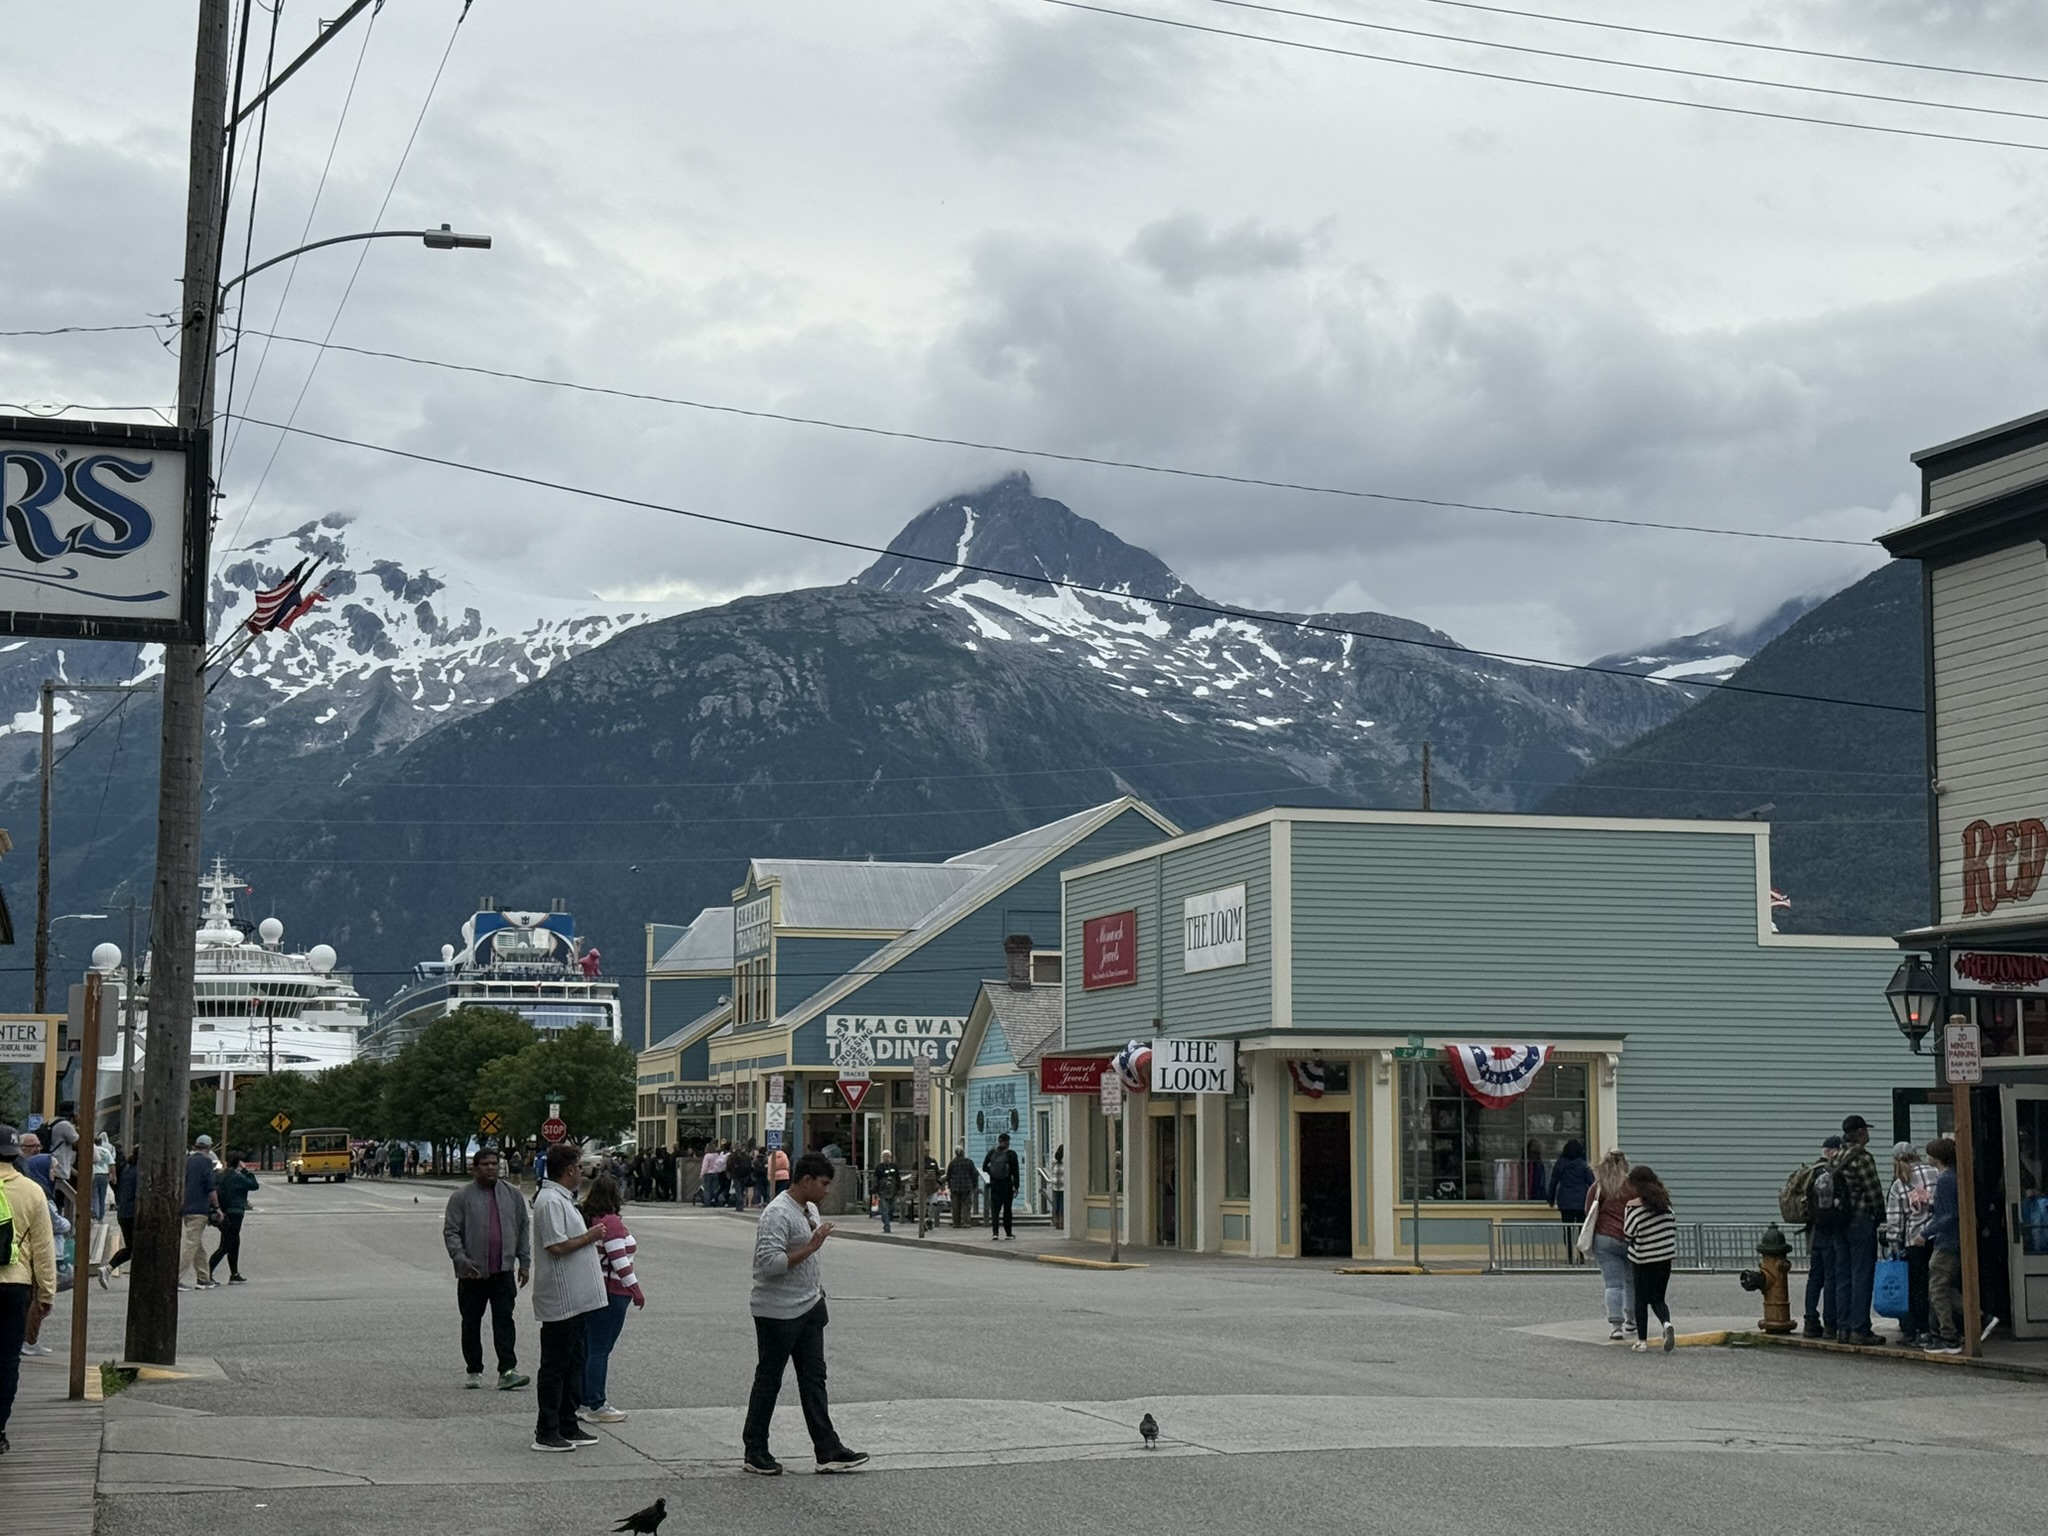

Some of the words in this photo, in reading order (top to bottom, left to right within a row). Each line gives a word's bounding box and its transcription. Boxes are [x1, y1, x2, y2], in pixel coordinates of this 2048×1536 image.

[1961, 818, 2048, 918] RED
[738, 900, 769, 927] SKAGWAY
[1186, 914, 1208, 951] THE
[1210, 906, 1243, 946] LOOM
[1957, 1033, 1967, 1041] 20
[835, 1028, 873, 1066] CROSSING
[1170, 1040, 1217, 1063] THE
[1950, 1042, 1975, 1050] MINUTE
[1415, 1049, 1429, 1058] AVE
[1949, 1050, 1978, 1058] PARKING
[1053, 1062, 1096, 1072] Monarch
[1060, 1072, 1090, 1085] Jewels
[1159, 1067, 1227, 1092] LOOM
[662, 1095, 715, 1103] TRADING
[716, 1094, 734, 1102] CO
[544, 1124, 564, 1134] STOP
